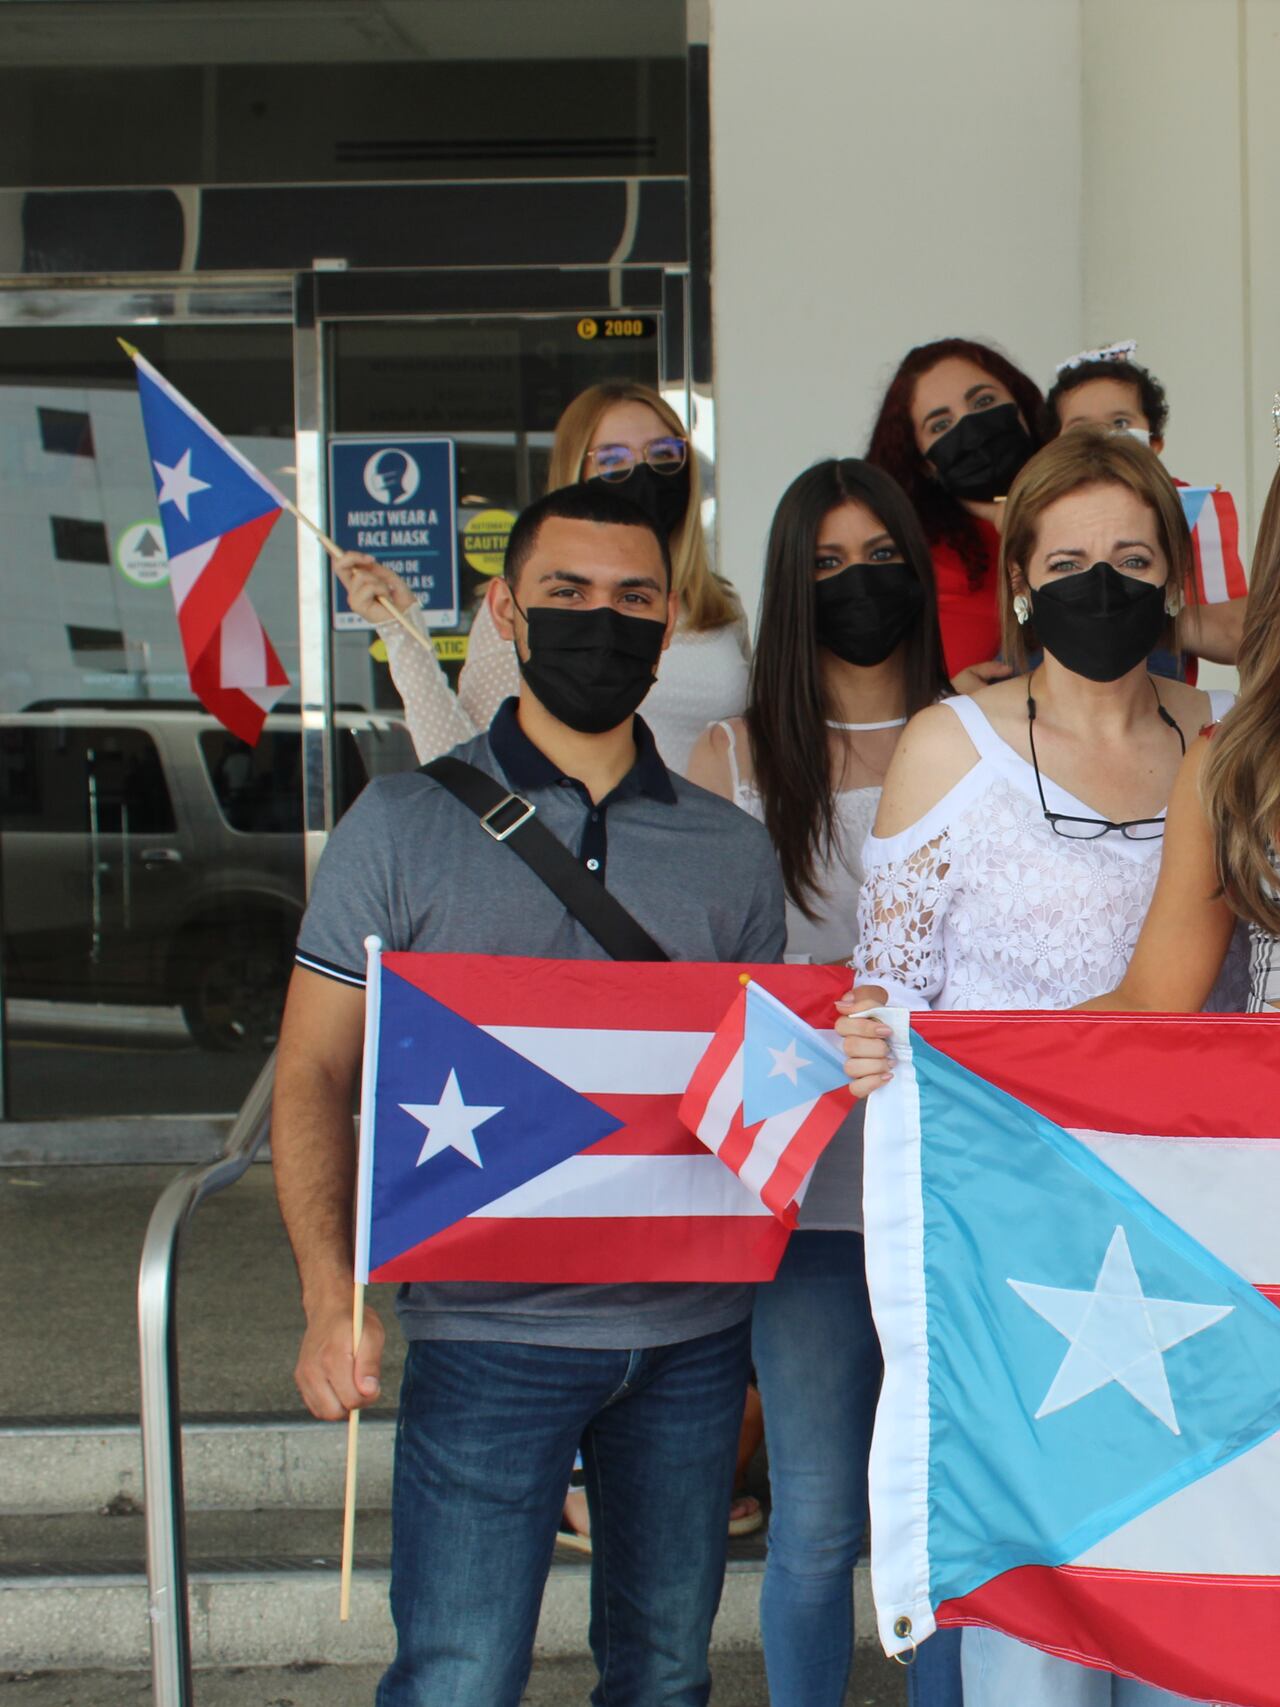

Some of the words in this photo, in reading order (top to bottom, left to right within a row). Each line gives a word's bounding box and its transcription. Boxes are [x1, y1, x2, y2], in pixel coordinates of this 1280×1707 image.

[604, 320, 642, 336] 2000
[347, 511, 384, 526] MUST
[387, 510, 427, 525] WEAR
[428, 509, 438, 524] A
[357, 531, 388, 547] FACE
[390, 530, 430, 546] MASK
[405, 560, 418, 573] DE
[421, 575, 435, 588] ES
